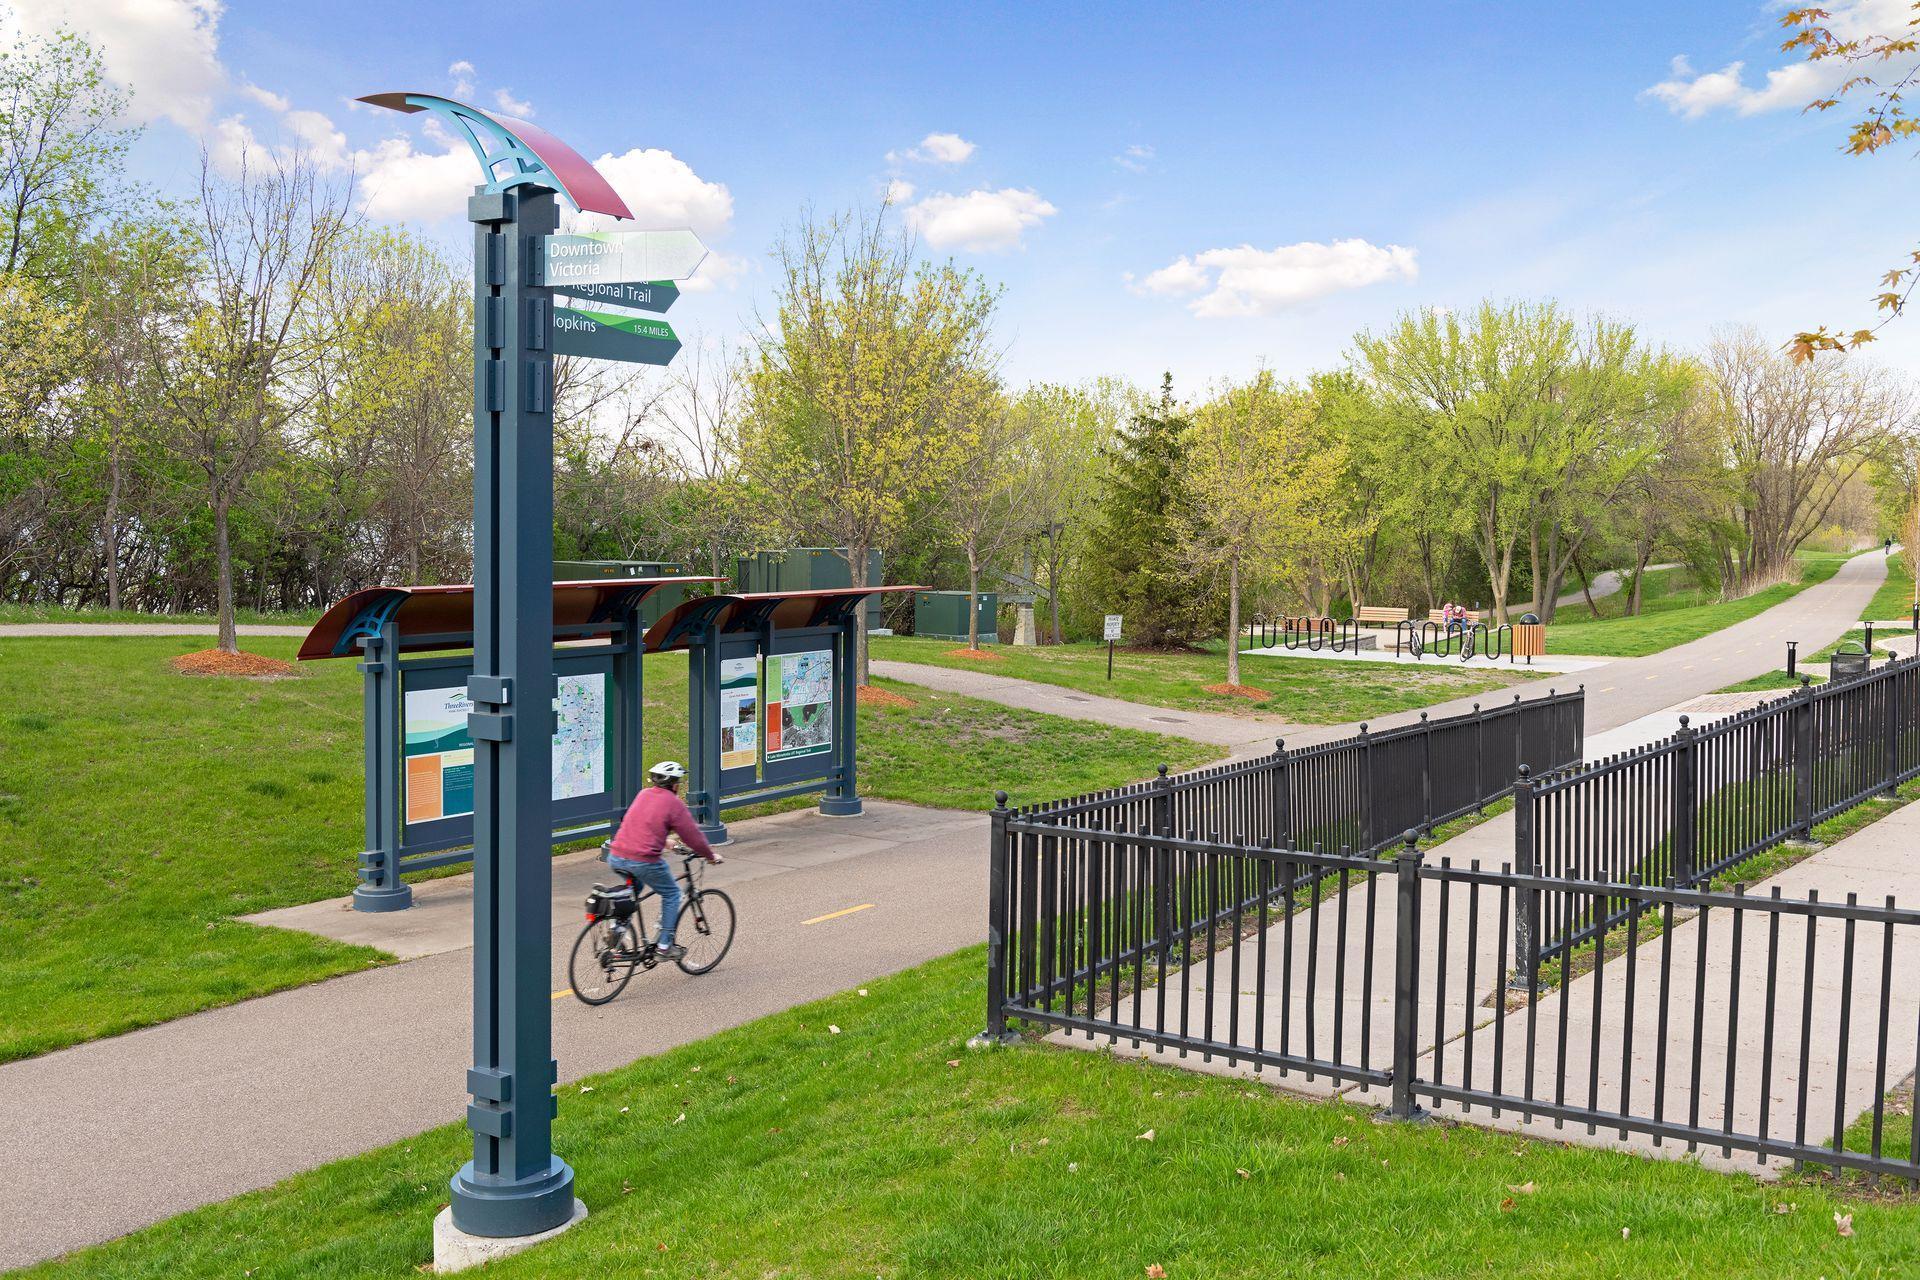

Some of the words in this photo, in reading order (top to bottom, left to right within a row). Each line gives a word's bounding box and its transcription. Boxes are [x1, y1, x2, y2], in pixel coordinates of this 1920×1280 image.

[550, 241, 624, 258] Downtown
[550, 260, 600, 277] Victoria
[627, 286, 651, 303] Trail
[553, 313, 596, 333] opkins
[634, 324, 648, 335] 15.4
[649, 325, 669, 337] MILES
